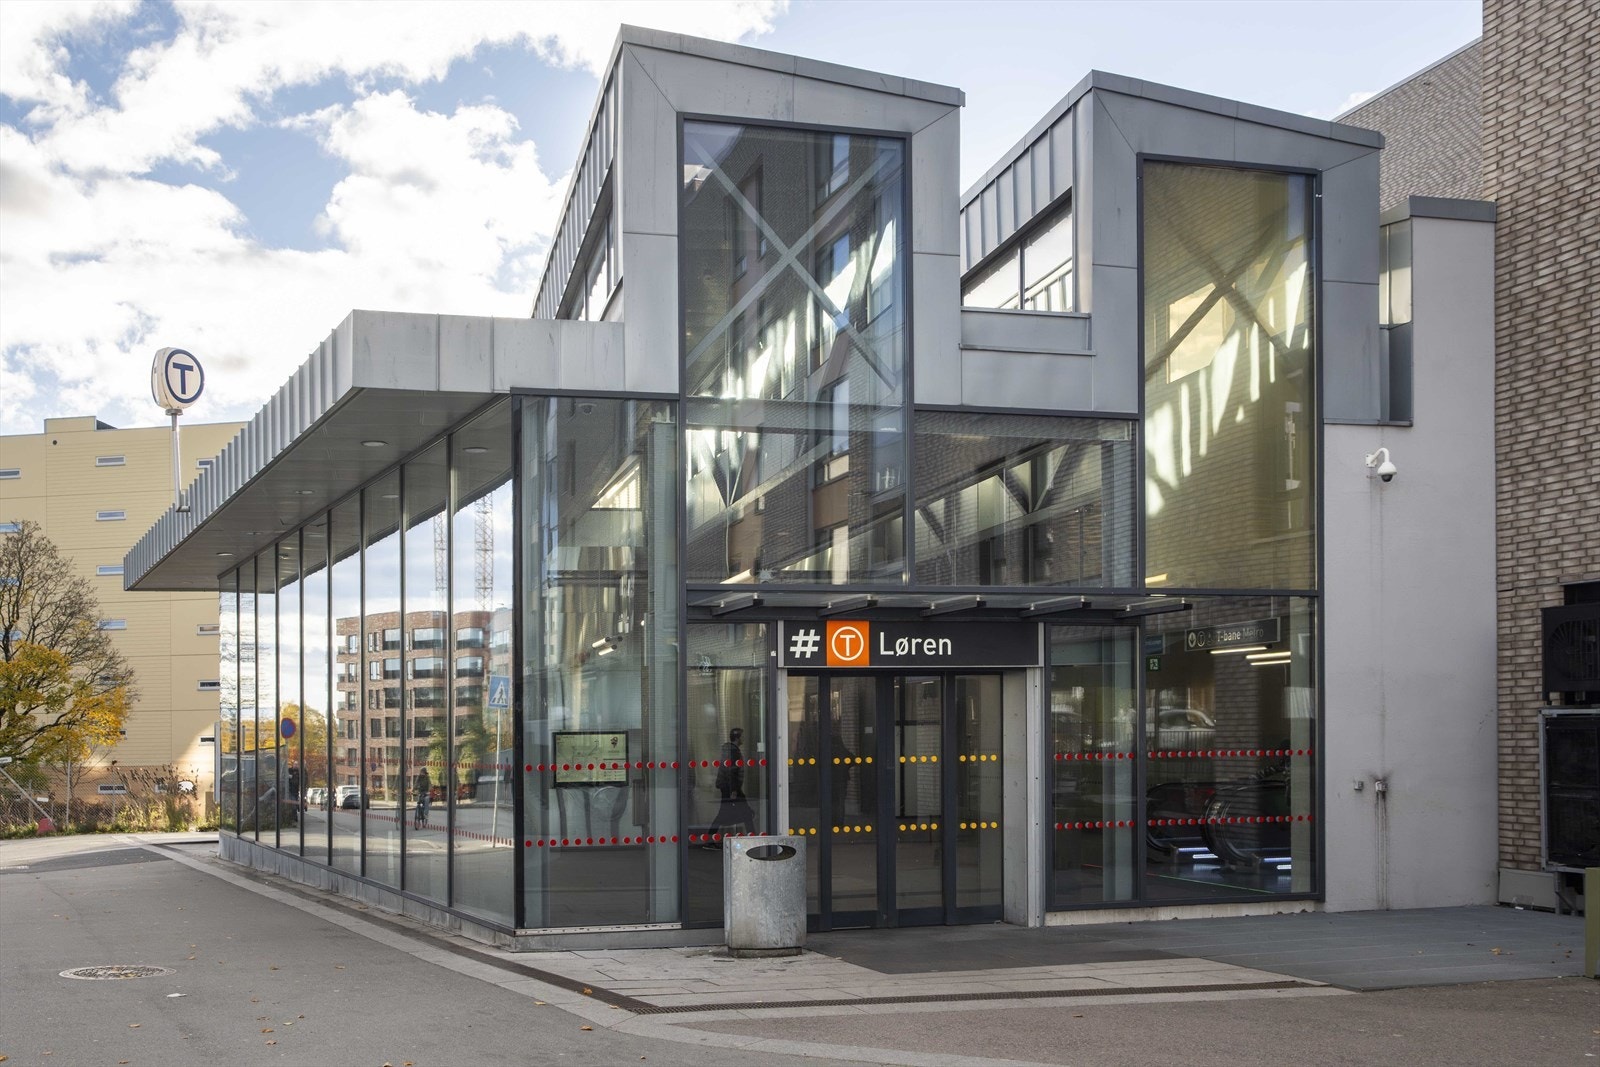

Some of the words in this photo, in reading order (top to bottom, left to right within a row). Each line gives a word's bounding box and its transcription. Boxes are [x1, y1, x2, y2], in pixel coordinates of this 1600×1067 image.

[173, 362, 194, 395] T
[789, 629, 821, 659] #
[839, 634, 856, 657] T
[879, 631, 952, 656] Løren
[1216, 629, 1241, 642] T-bane
